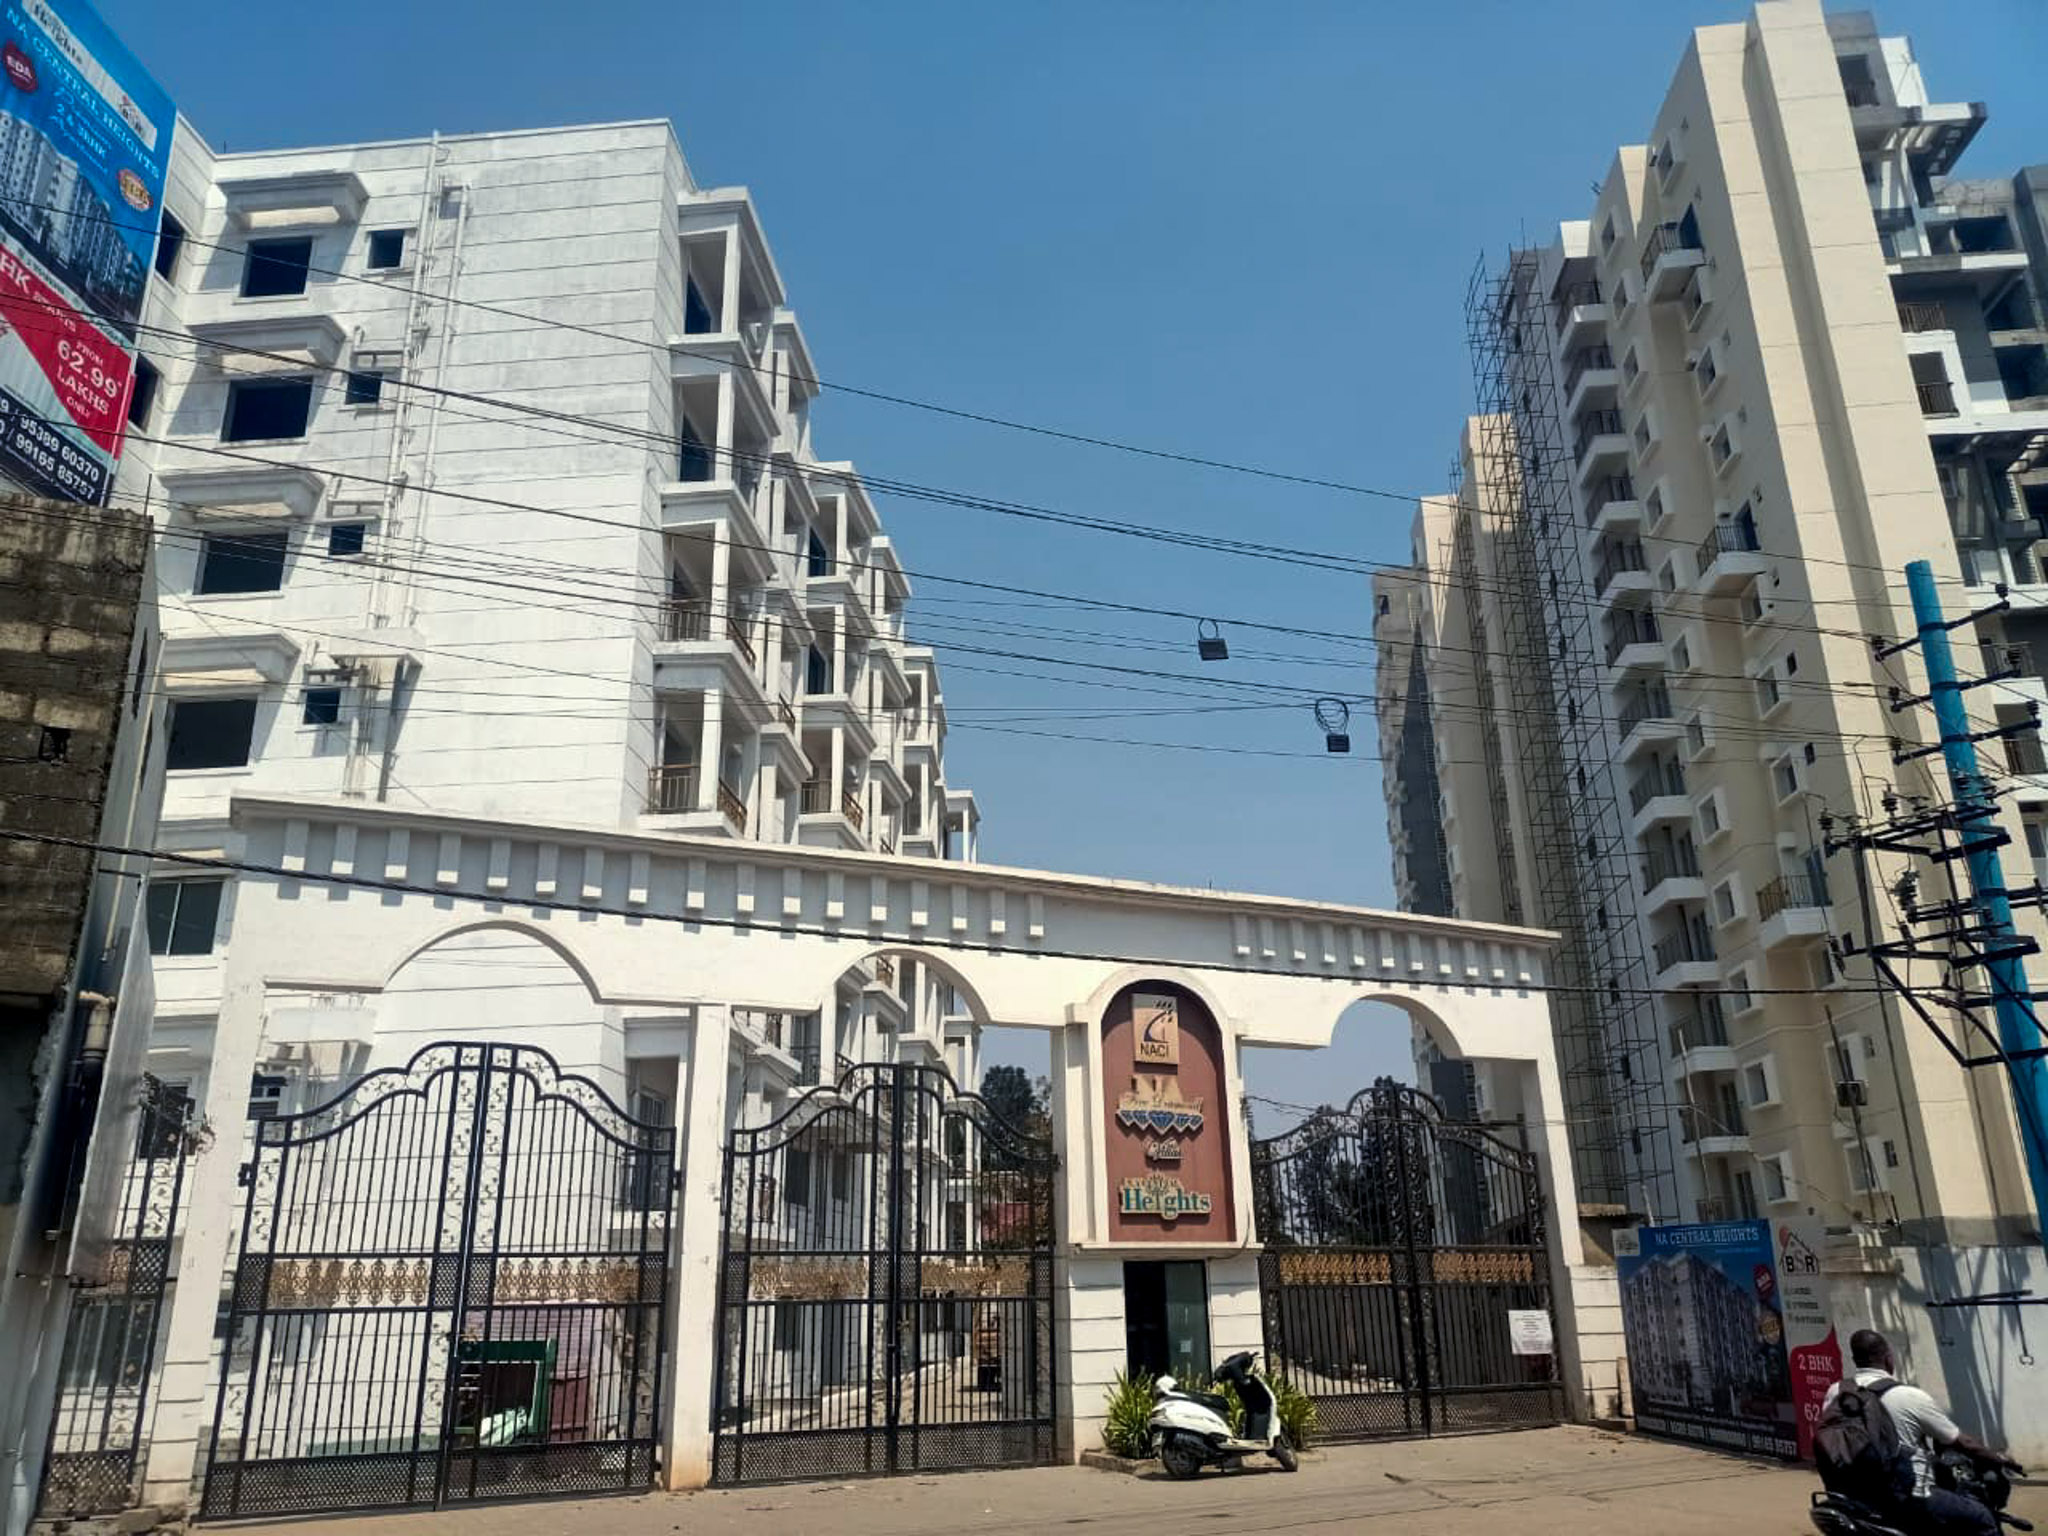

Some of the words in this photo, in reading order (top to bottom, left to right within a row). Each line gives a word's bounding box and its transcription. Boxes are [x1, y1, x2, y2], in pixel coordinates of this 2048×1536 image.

[32, 37, 99, 116] CENTRAL
[102, 112, 160, 179] HEIGHTS
[57, 365, 110, 415] LAKHS
[16, 433, 55, 471] 99165
[61, 445, 99, 482] 60370
[1122, 1188, 1211, 1218] Heights
[1669, 1229, 1713, 1245] CENTRAL
[1714, 1226, 1760, 1242] HEIGHTS
[1785, 1253, 1816, 1273] BSR
[1797, 1354, 1806, 1370] 2
[1807, 1355, 1835, 1372] BHK
